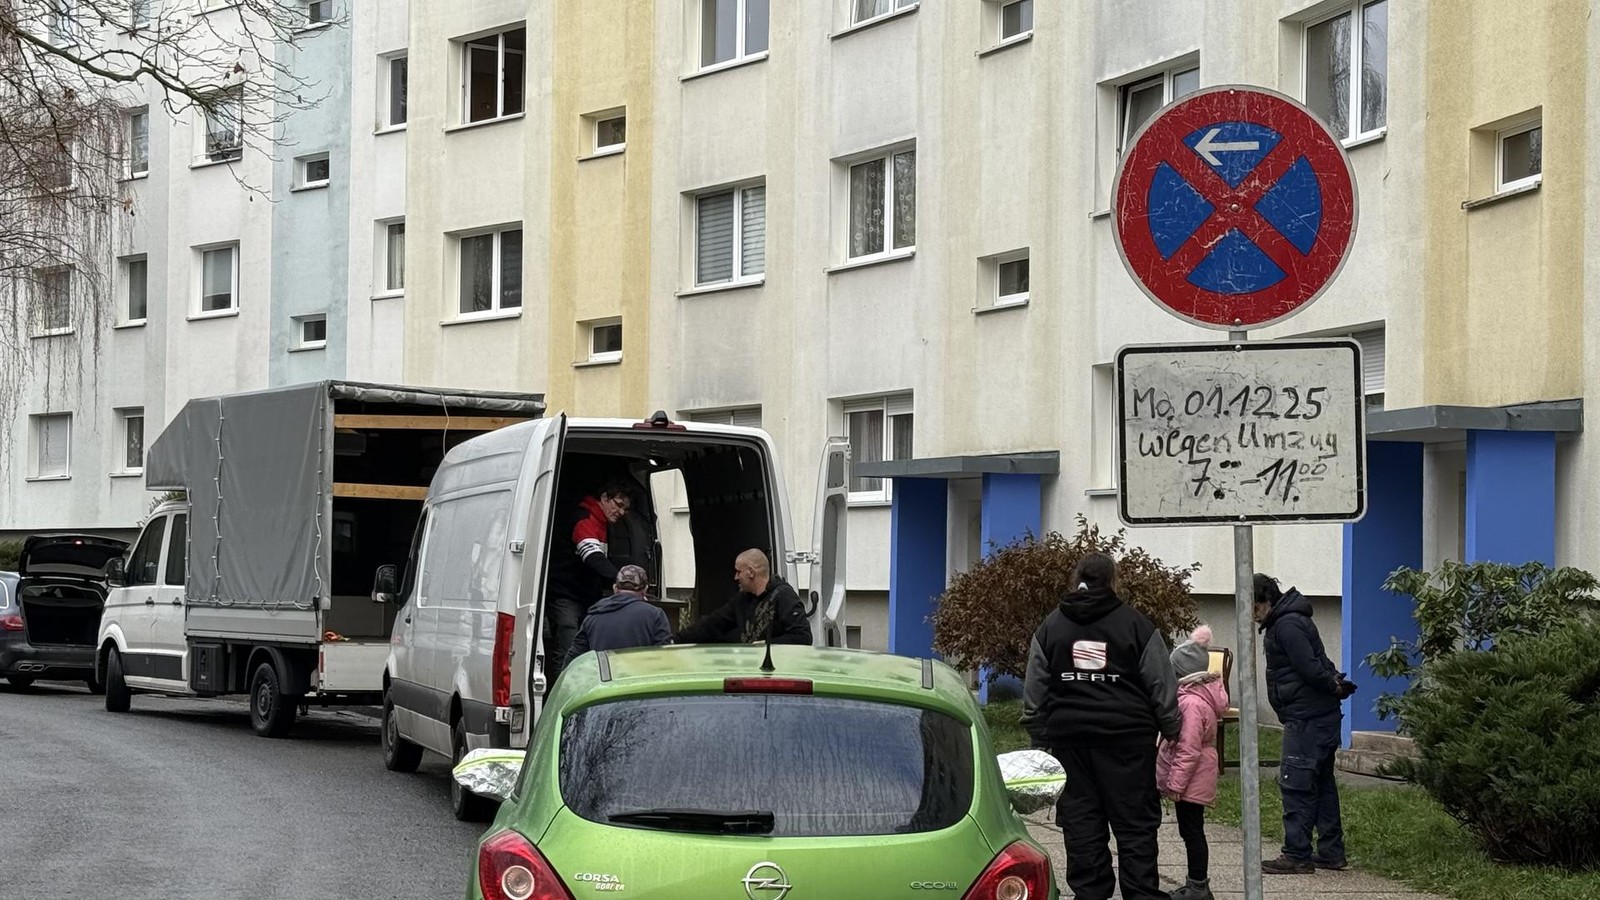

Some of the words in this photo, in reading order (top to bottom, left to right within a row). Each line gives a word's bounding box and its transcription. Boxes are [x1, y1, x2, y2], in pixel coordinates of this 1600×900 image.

[1237, 422, 1338, 460] Umzug
[1060, 672, 1120, 683] SEAT
[574, 872, 620, 883] CORSA
